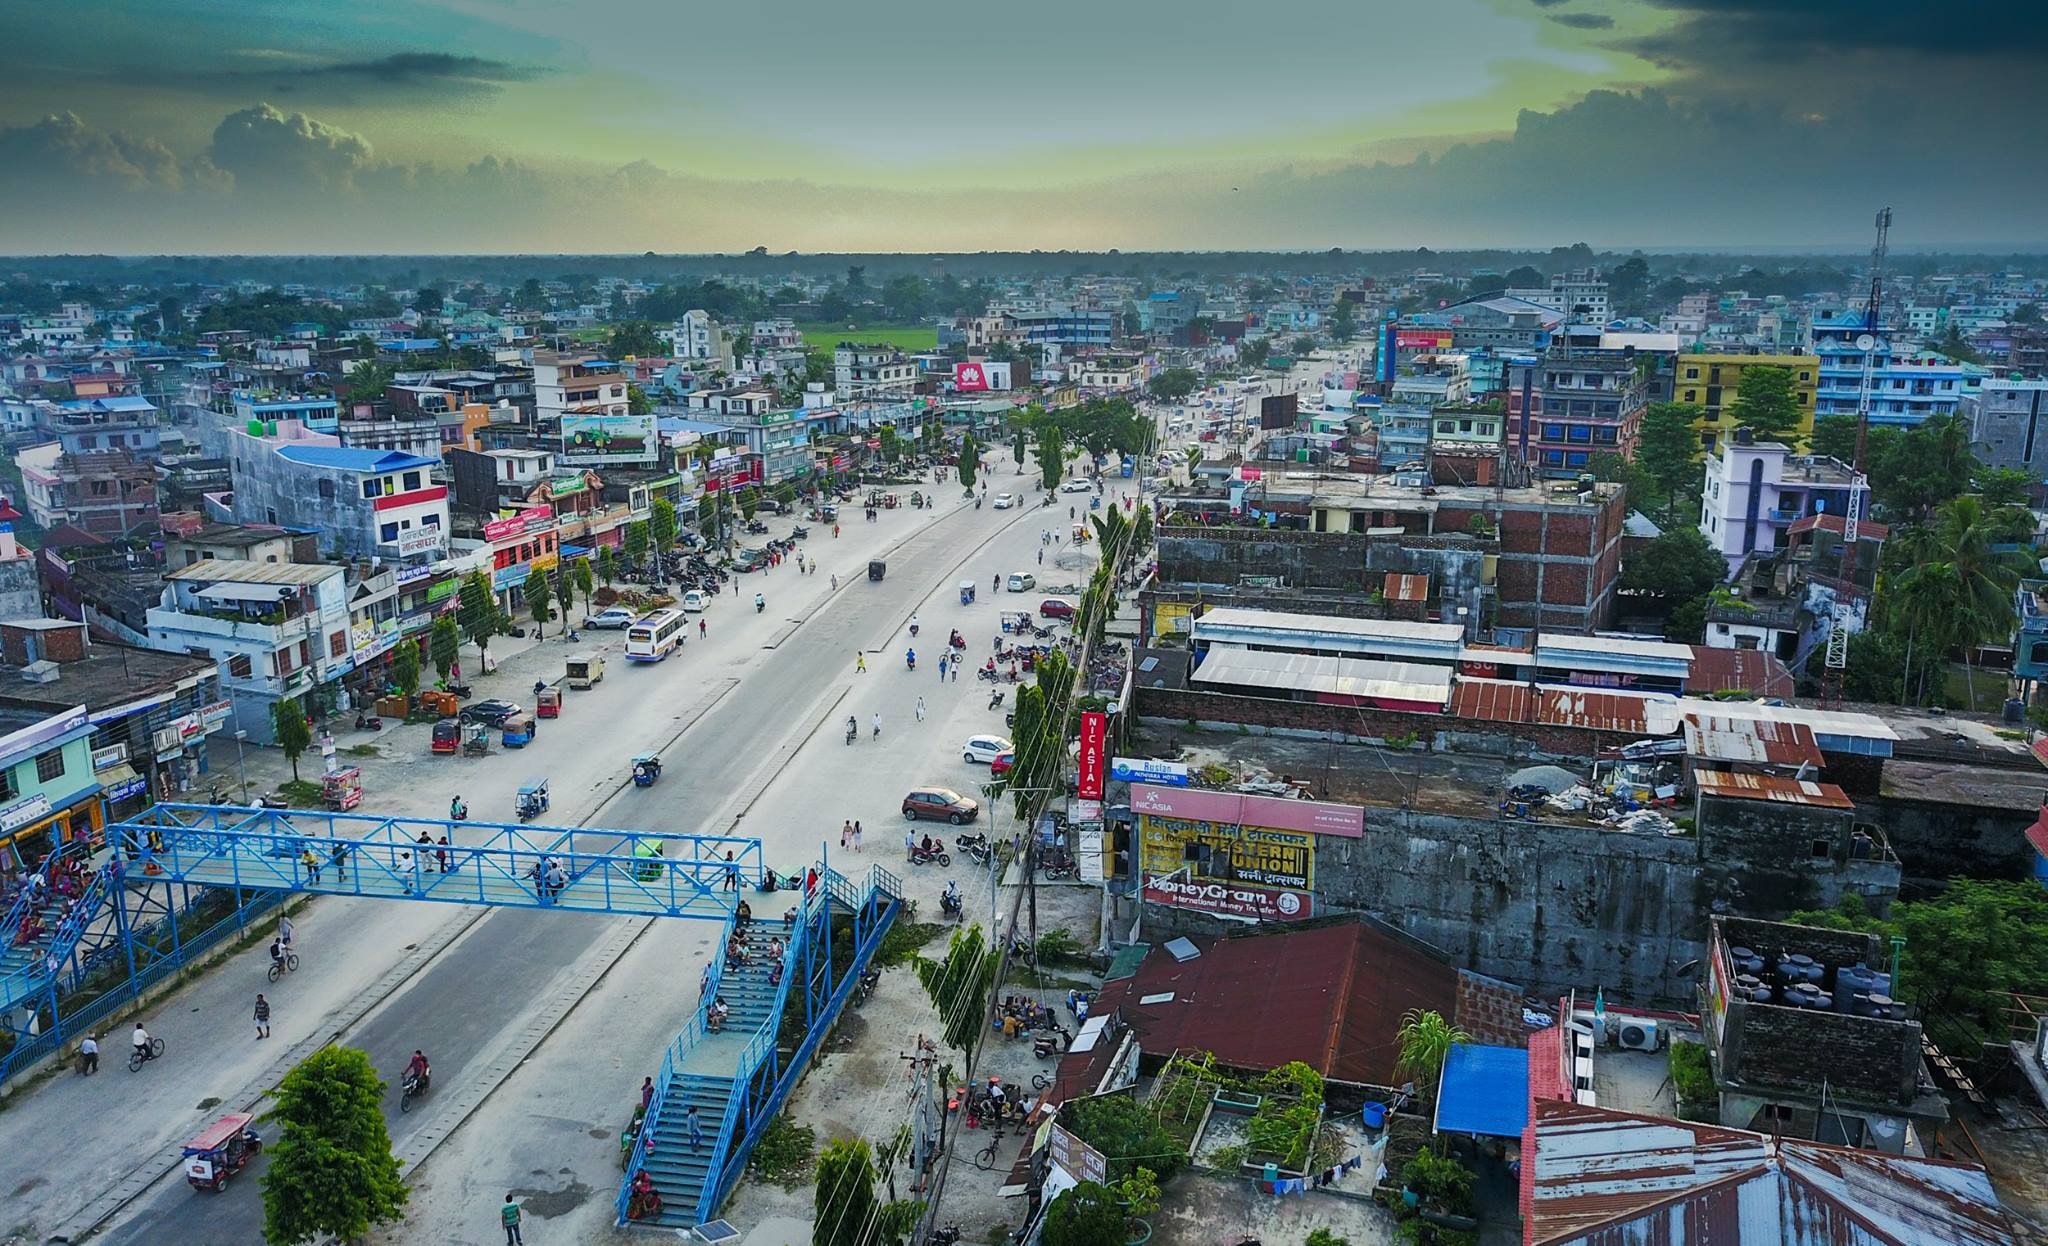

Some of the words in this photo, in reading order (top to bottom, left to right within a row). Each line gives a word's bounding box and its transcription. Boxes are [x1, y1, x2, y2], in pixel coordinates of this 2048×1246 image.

[1088, 717, 1097, 744] NIC
[1086, 747, 1096, 782] ASIA
[1135, 800, 1151, 811] NIC
[1152, 802, 1173, 813] ASIA
[1232, 855, 1295, 873] UNION
